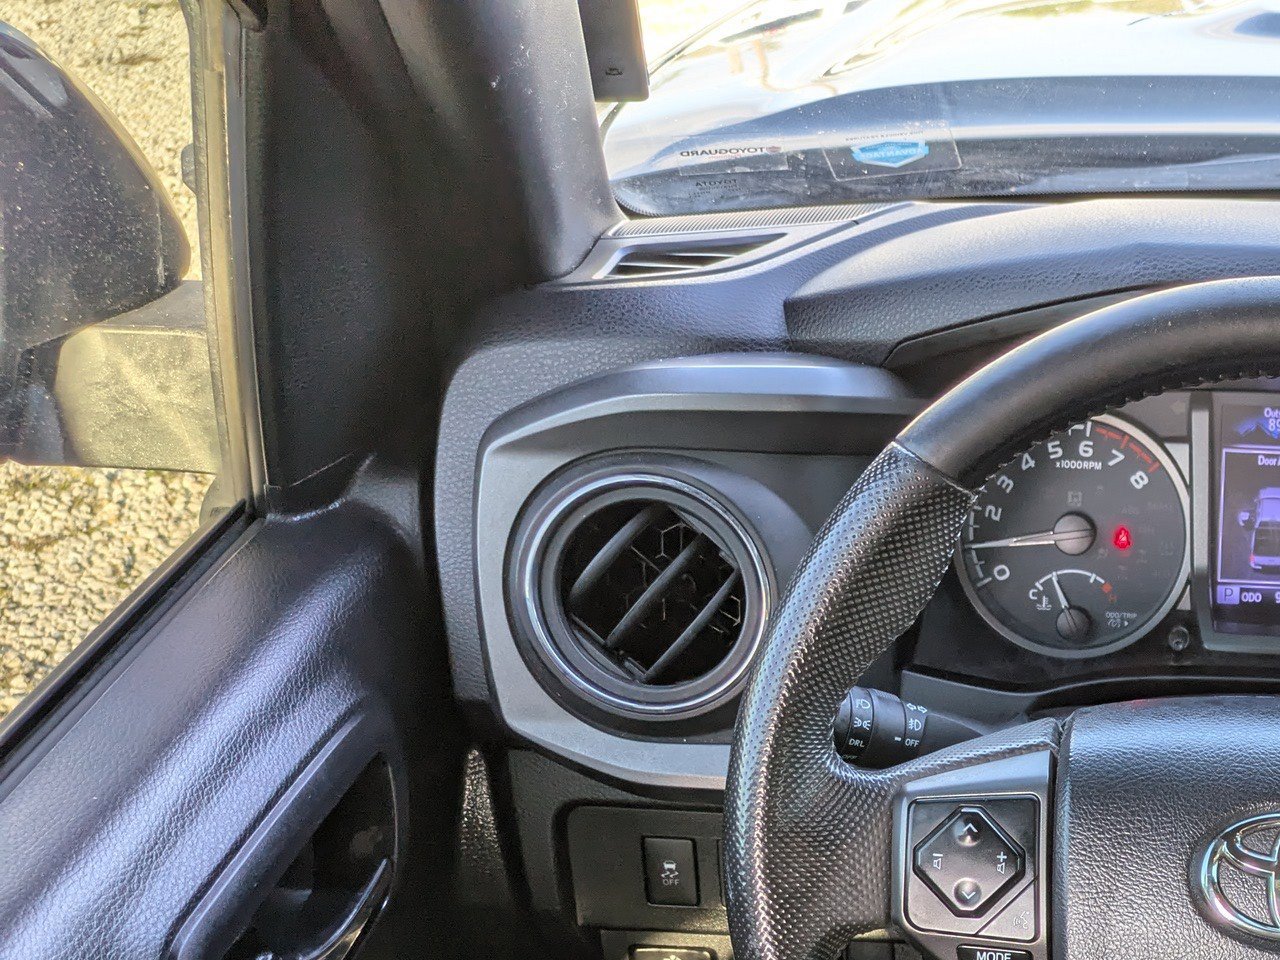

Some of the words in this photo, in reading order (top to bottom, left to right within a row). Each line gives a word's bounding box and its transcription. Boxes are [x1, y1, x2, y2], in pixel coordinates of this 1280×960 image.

[1047, 441, 1063, 459] 5
[1079, 441, 1094, 458] 6
[1021, 452, 1036, 471] 4
[1108, 450, 1125, 467] 7
[1257, 455, 1277, 467] Door
[997, 475, 1014, 494] 3
[1130, 471, 1149, 490] 8
[985, 505, 1002, 522] 2
[993, 565, 1010, 581] 0
[1029, 589, 1038, 600] C
[1224, 587, 1234, 599] P
[1241, 591, 1262, 603] ODO
[848, 738, 865, 748] DRL
[905, 738, 920, 748] OFF
